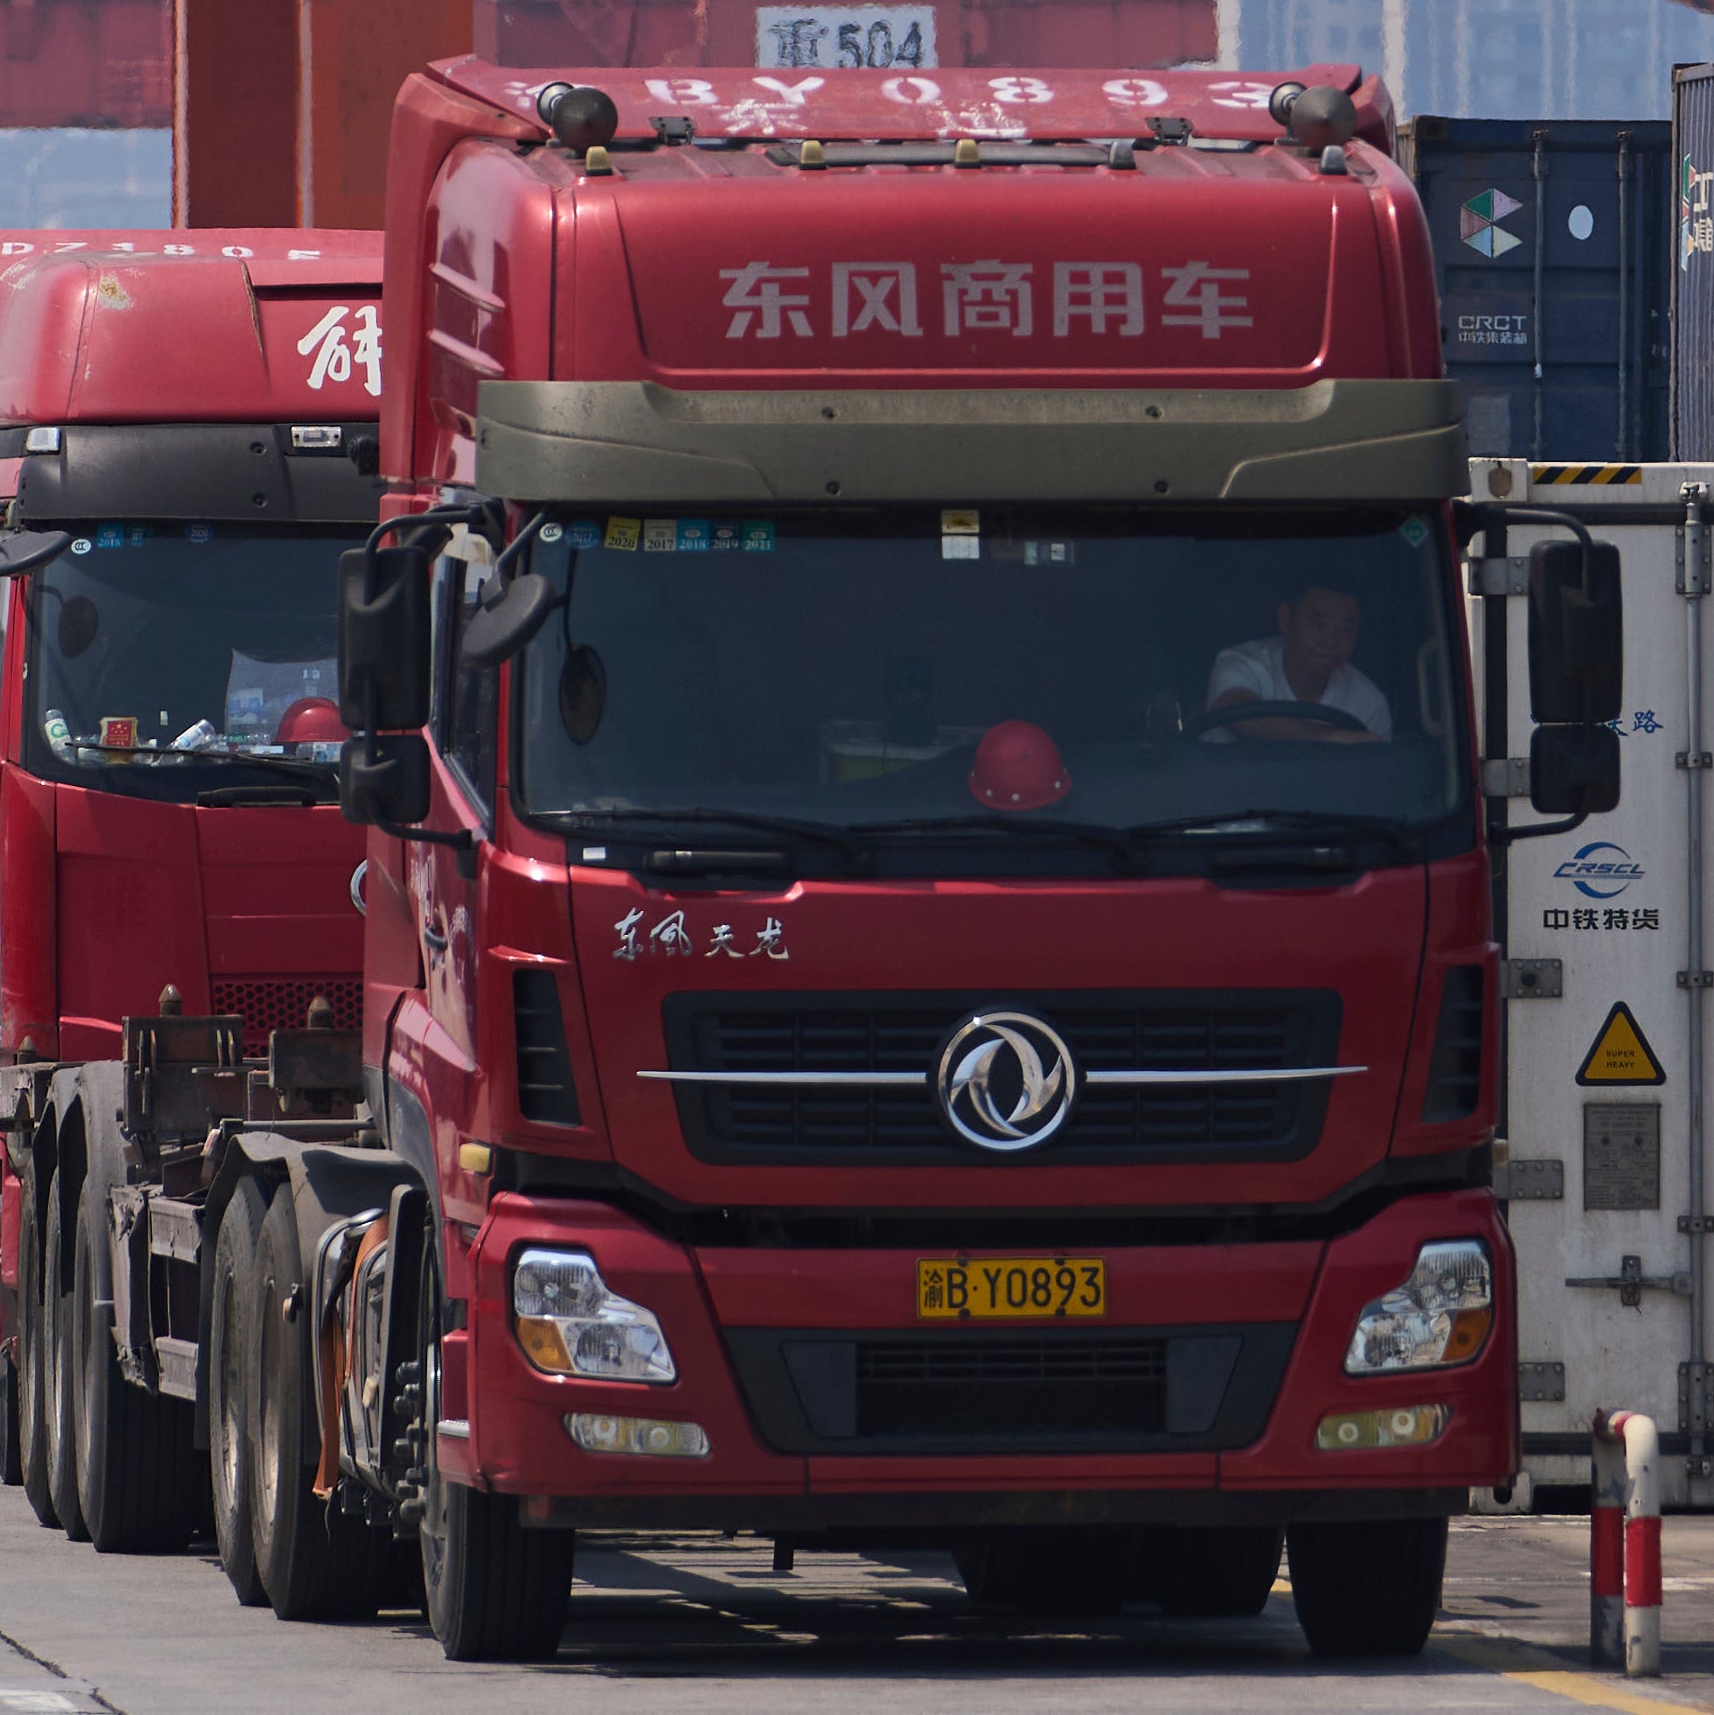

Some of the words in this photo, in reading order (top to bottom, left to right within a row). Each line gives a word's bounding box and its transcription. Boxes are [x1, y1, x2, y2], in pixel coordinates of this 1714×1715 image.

[718, 259, 1254, 341] 东风商用车
[1458, 315, 1528, 331] CRCT
[1553, 862, 1646, 879] CRSCL
[1543, 908, 1659, 930] 中铁特货
[1606, 1049, 1636, 1058] SUPER
[1606, 1060, 1636, 1069] HEAVY
